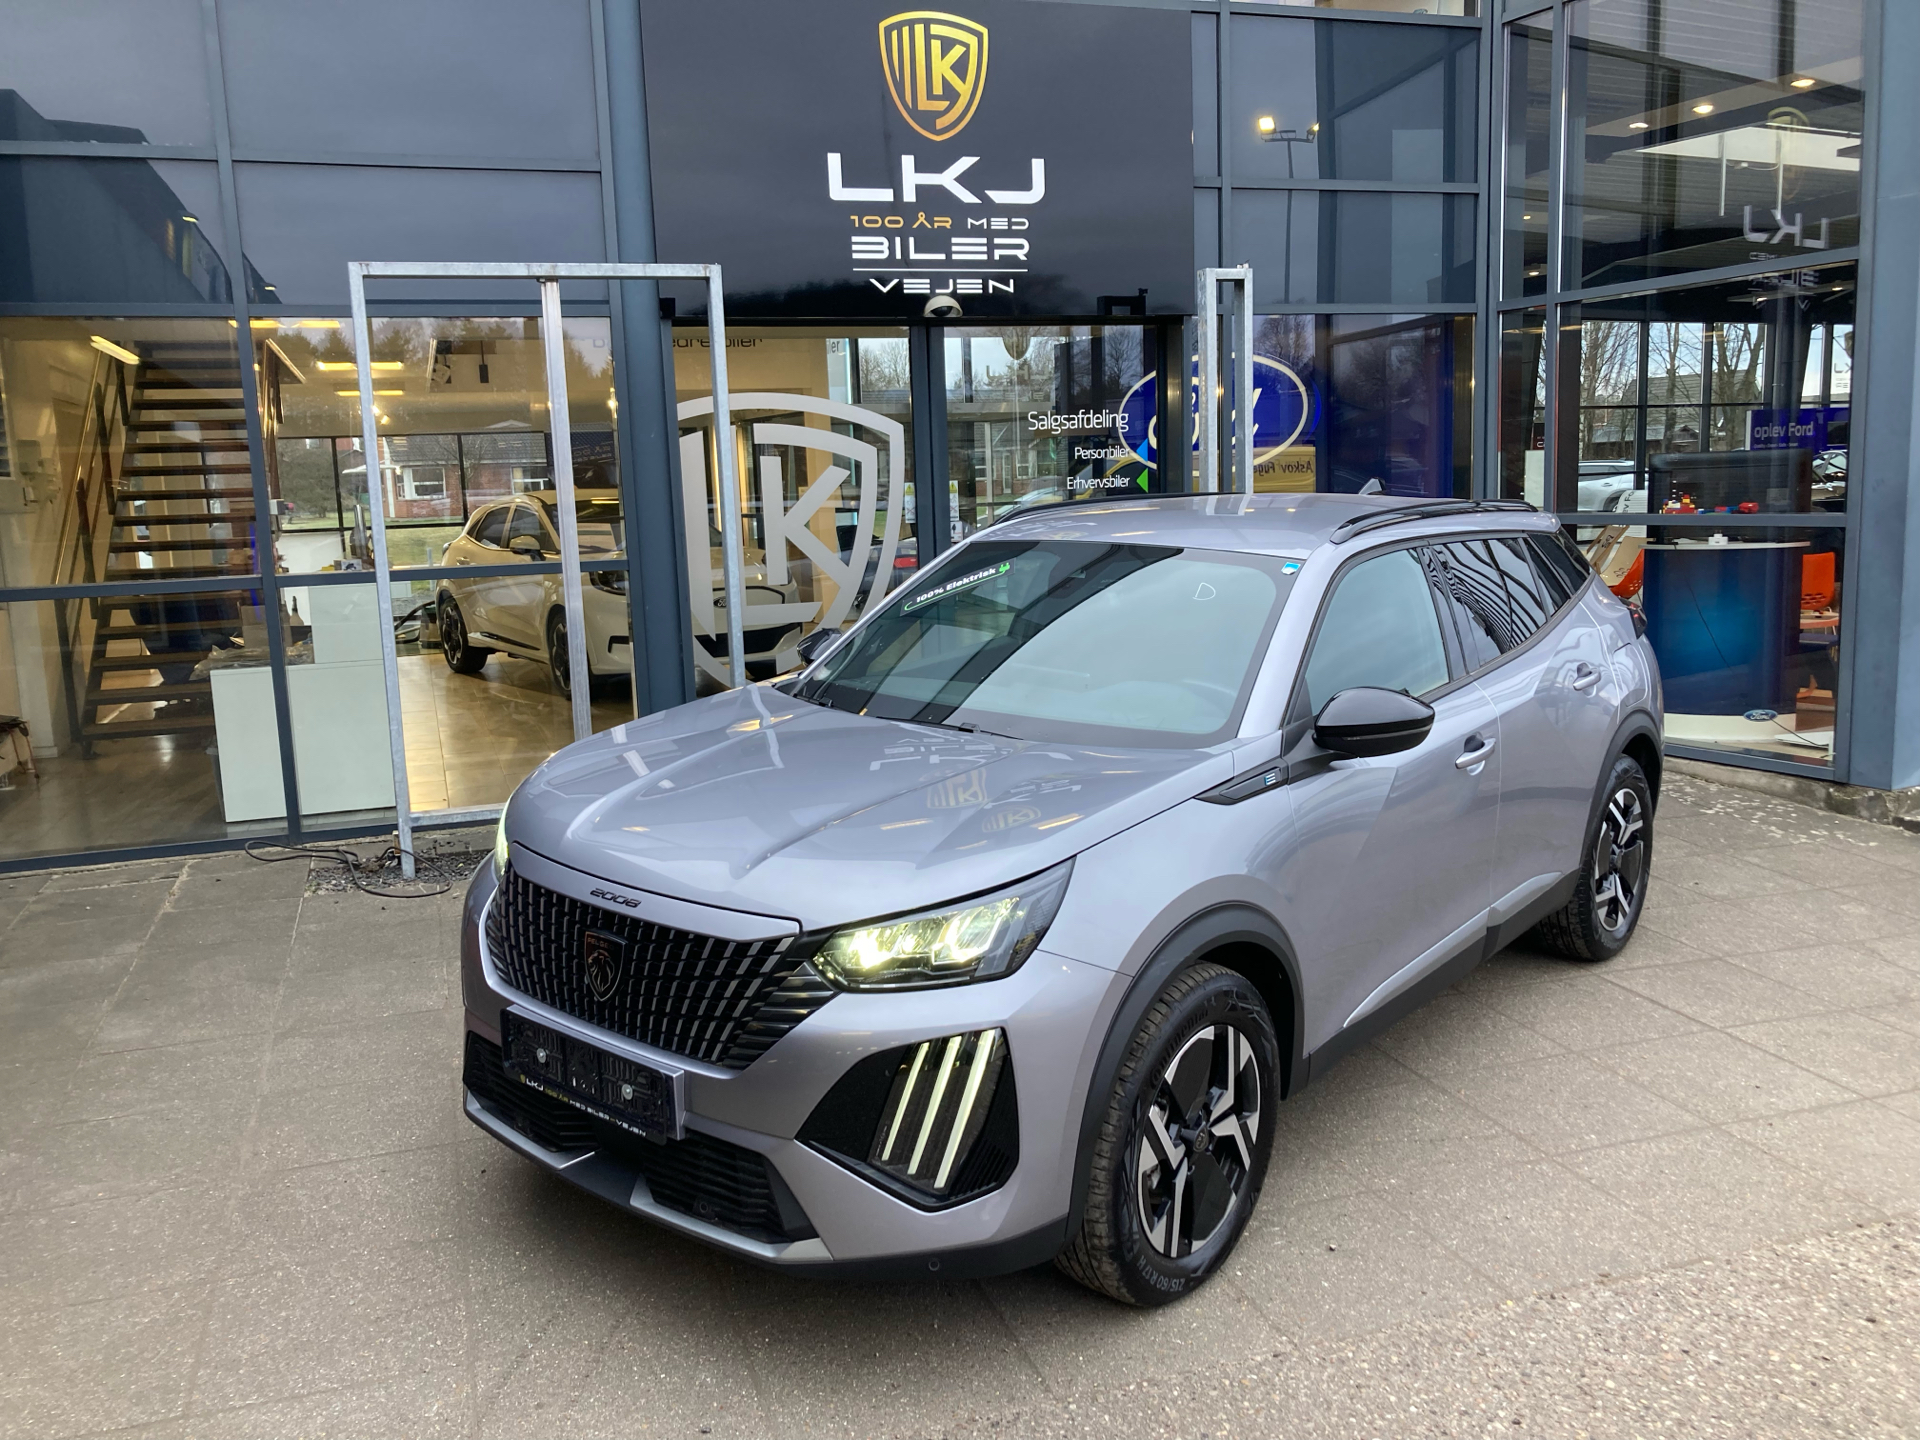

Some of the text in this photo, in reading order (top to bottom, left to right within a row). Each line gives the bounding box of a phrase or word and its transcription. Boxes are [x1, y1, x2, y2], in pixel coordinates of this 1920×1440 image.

[827, 152, 1046, 204] LKJ
[850, 212, 1029, 230] 100 ÅR MED
[851, 236, 1030, 261] BILER
[869, 278, 1015, 294] VEJEN
[1027, 409, 1129, 434] Salgsafdeling
[1754, 421, 1814, 440] oplev Ford
[1074, 445, 1130, 460] Personbiler
[1066, 474, 1131, 490] Erhvervsbiler
[916, 568, 997, 603] 100% Elektrisk
[590, 887, 642, 908] 2008
[525, 1078, 544, 1092] LKJ
[616, 1119, 647, 1138] VEJEN
